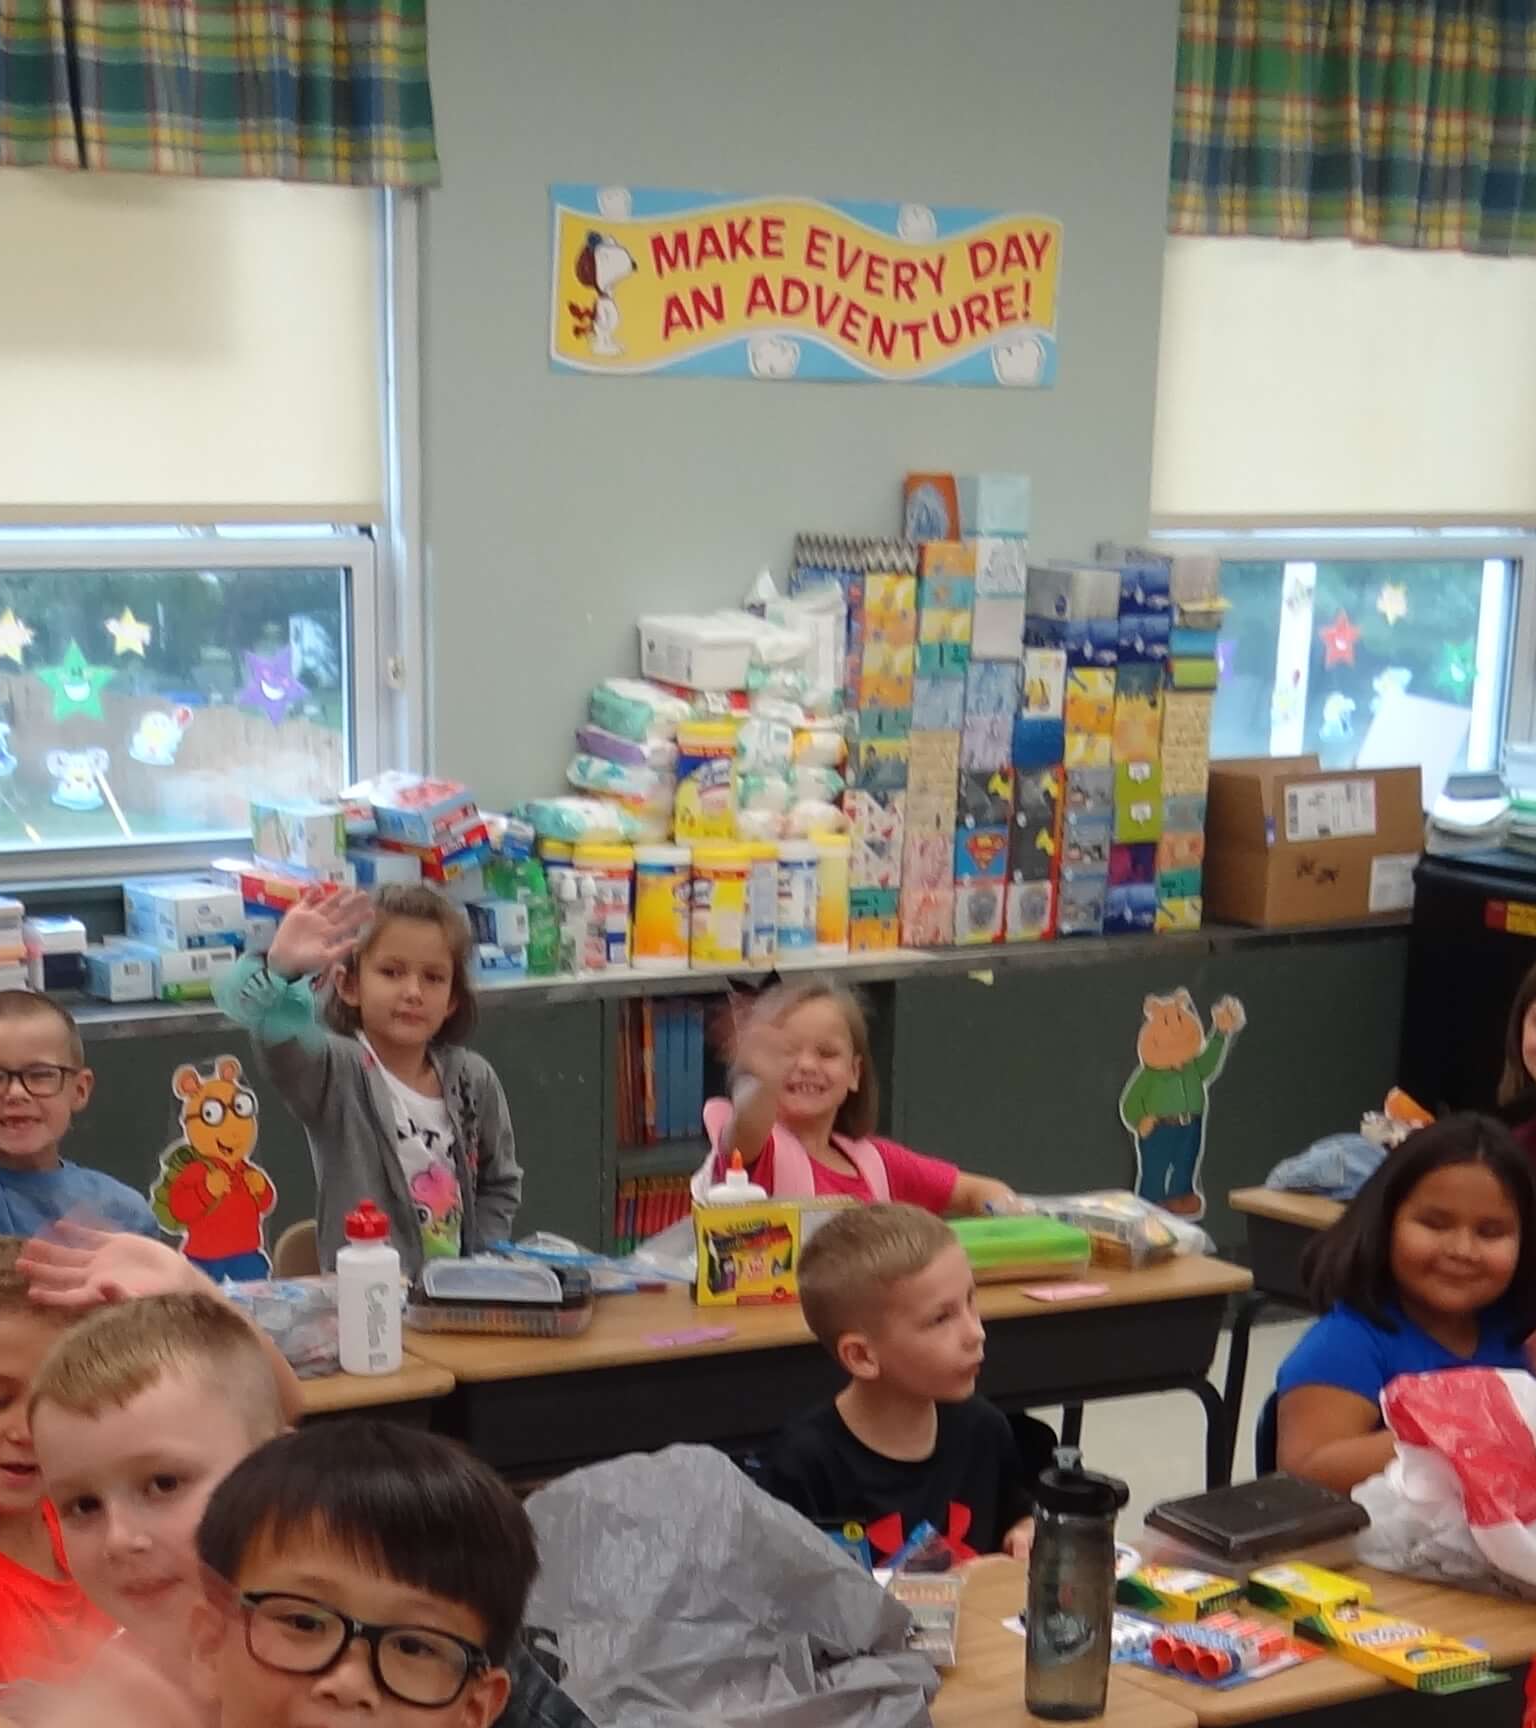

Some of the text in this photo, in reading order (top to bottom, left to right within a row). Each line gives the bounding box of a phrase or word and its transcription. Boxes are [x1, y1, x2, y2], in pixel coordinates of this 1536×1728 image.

[648, 215, 1052, 303] MAKE EVERY DAY
[661, 274, 1035, 362] AN ADVENTURE!
